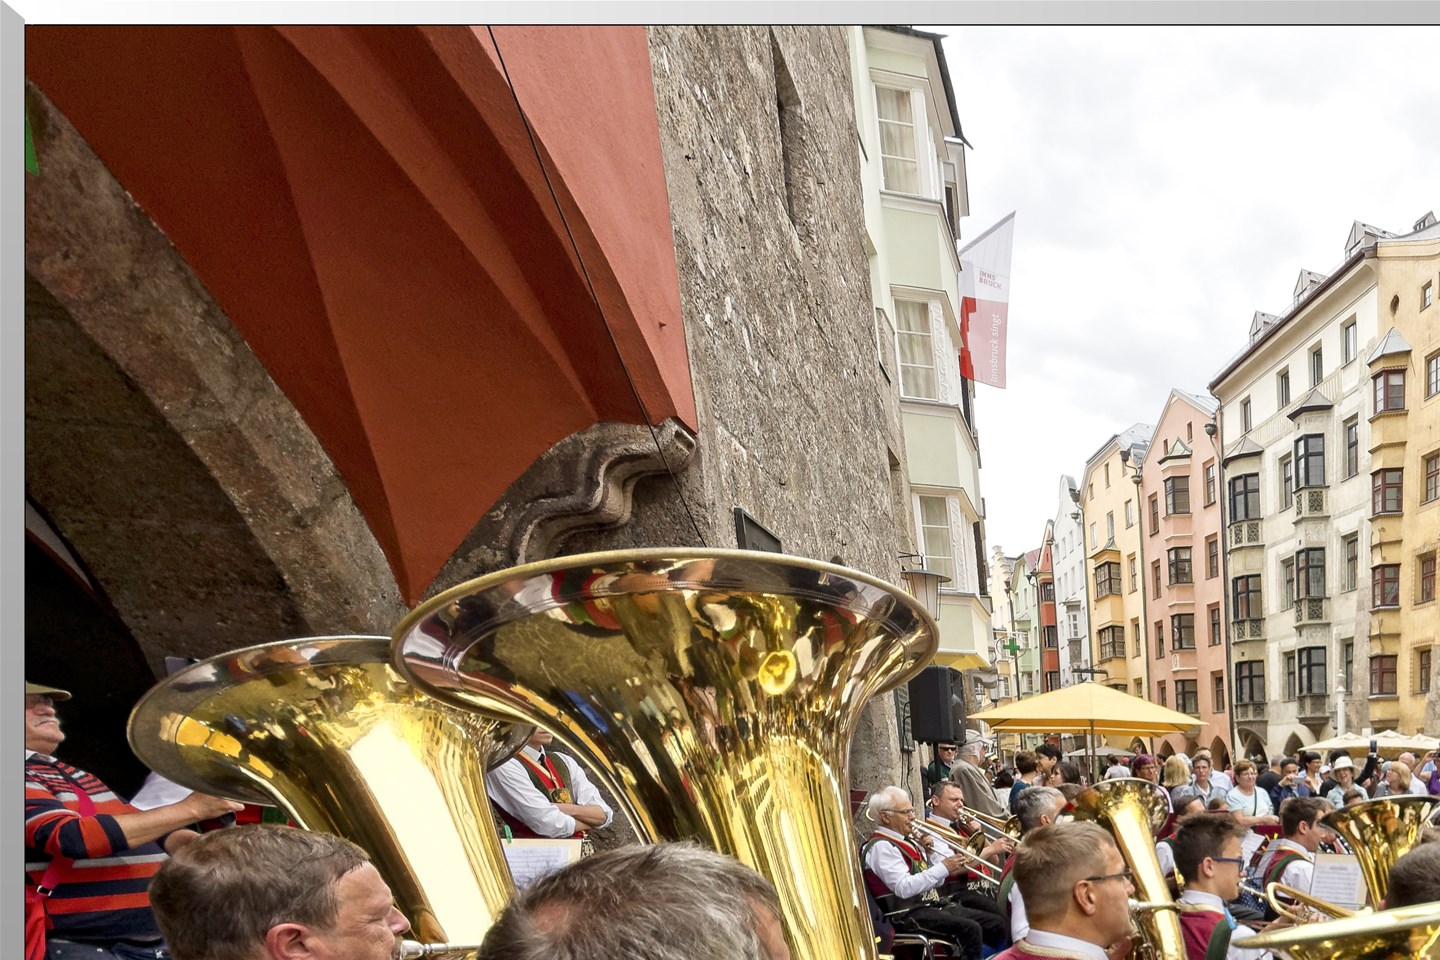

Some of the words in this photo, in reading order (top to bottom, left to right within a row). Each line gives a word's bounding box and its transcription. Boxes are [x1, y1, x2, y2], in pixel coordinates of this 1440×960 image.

[978, 277, 1002, 290] BRUCK
[990, 314, 1002, 337] singt
[989, 338, 1000, 384] Innsbruck
